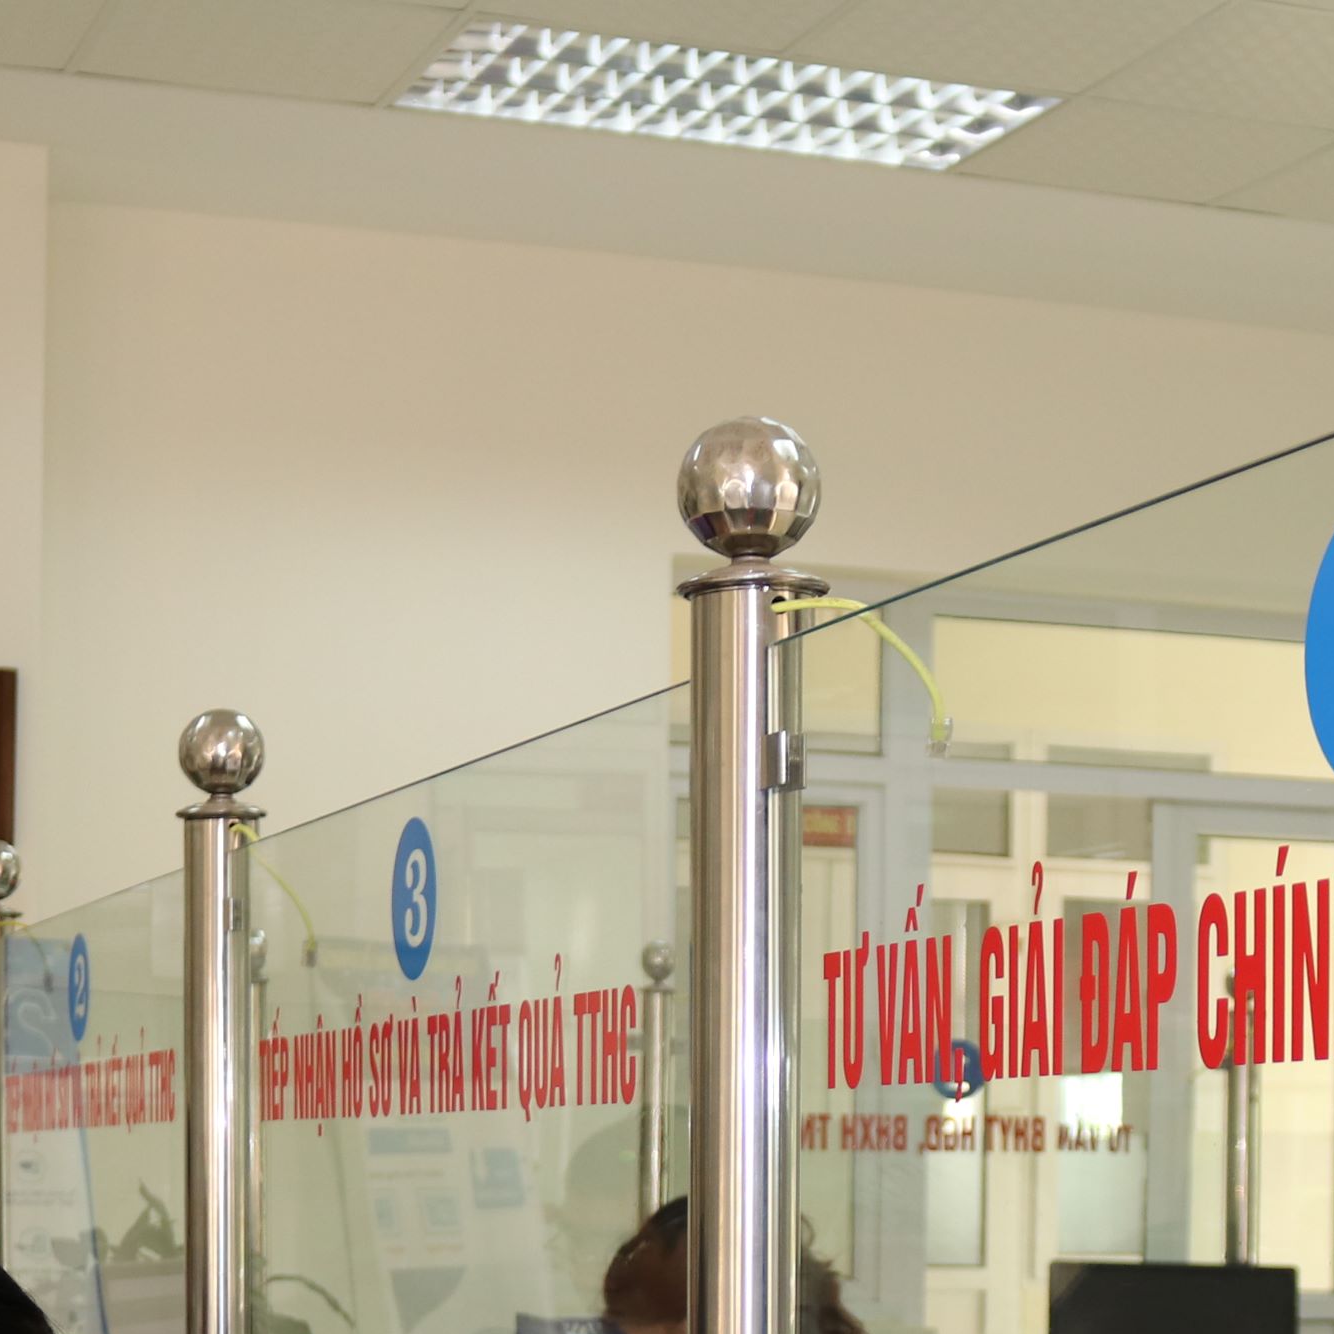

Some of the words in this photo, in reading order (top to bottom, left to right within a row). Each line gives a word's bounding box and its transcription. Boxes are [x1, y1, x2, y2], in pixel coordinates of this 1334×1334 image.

[404, 848, 428, 948] 3
[74, 955, 86, 1019] 2
[259, 1008, 289, 1122] TIẾP
[293, 1013, 337, 1137] NHẬN
[341, 993, 364, 1118] HỒ
[368, 1013, 394, 1118] SƠ
[398, 996, 421, 1115] VÀ
[427, 975, 465, 1113] TRẢ
[471, 970, 511, 1111] KẾT
[518, 953, 566, 1122] QUẢ
[574, 984, 637, 1106] TTHC
[823, 931, 870, 1090] TƯ
[979, 860, 1064, 1083] GIẢI
[1079, 870, 1177, 1075] ĐÁP
